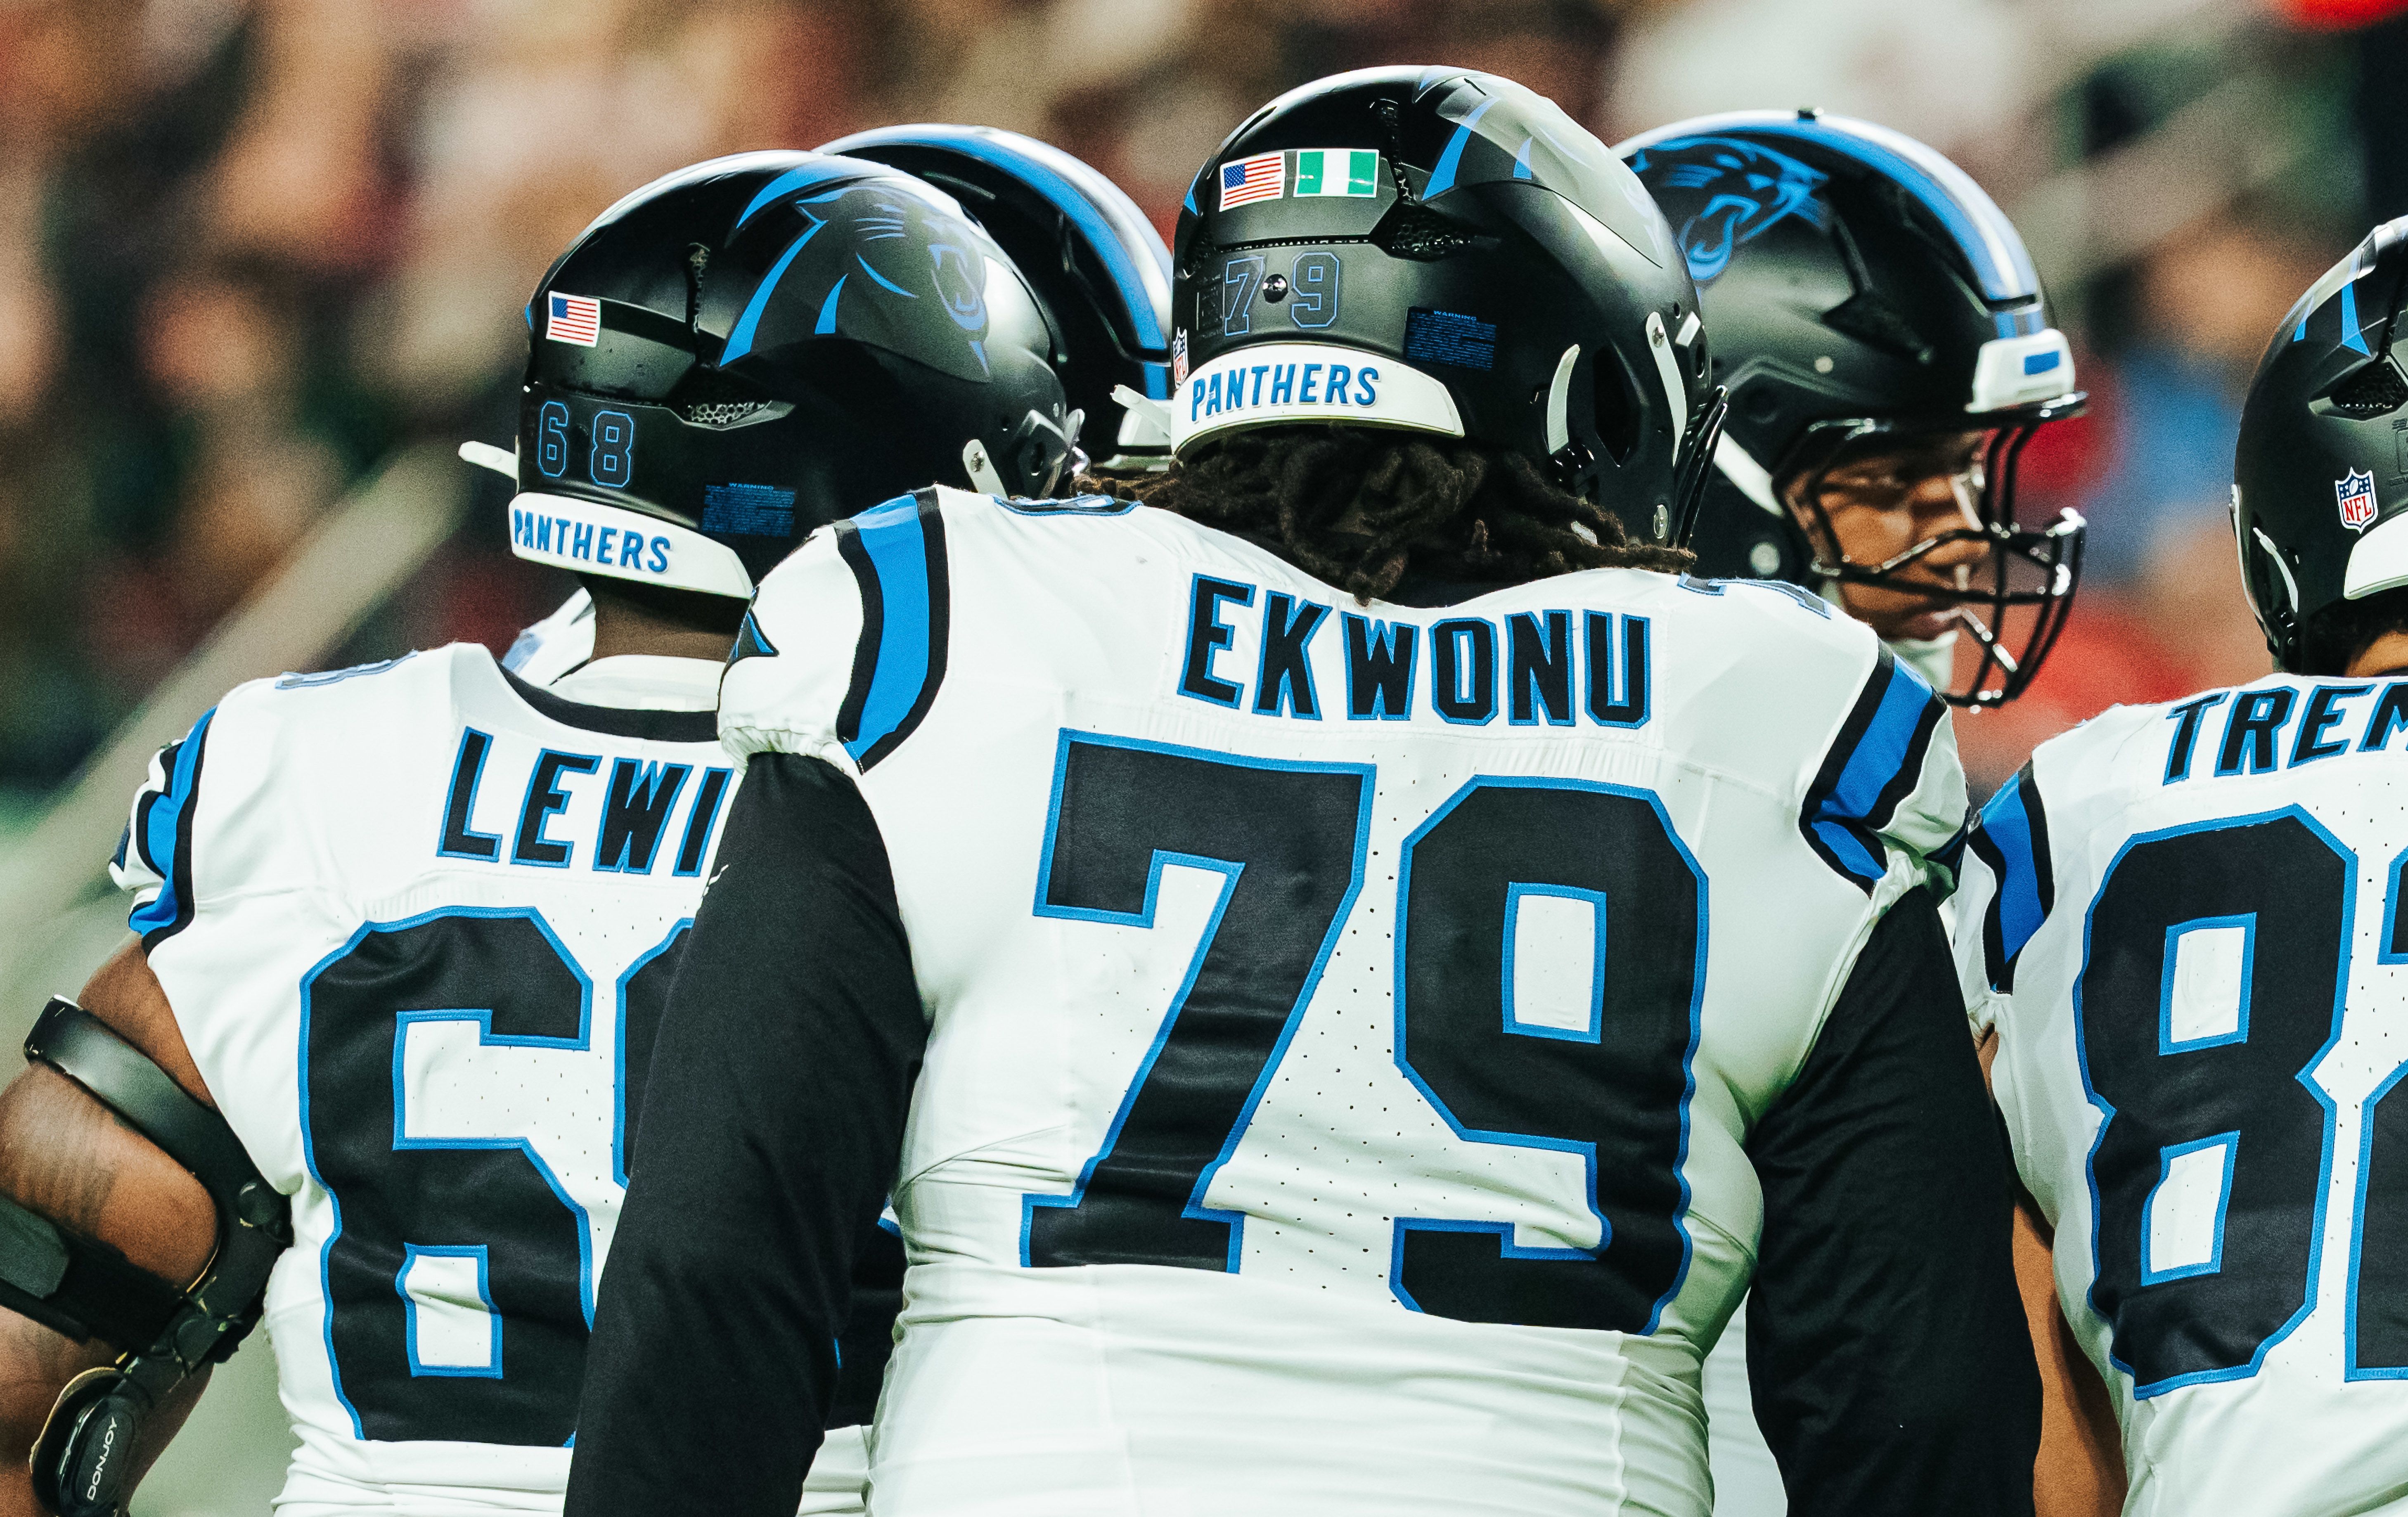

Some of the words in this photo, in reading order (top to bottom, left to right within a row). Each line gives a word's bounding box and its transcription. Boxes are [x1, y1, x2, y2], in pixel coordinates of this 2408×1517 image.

[1224, 252, 1340, 336] 79
[1433, 310, 1477, 321] WARNING
[1192, 364, 1380, 422] PANTHERS
[537, 400, 634, 488] 68
[514, 509, 670, 573] PANTHERS
[2344, 495, 2372, 521] NFL
[1177, 573, 1651, 729] EKWONU
[436, 726, 734, 877] LEWI
[1019, 727, 1709, 1336] 79
[2073, 803, 2408, 1400] 8
[87, 1416, 117, 1501] DONJOY
